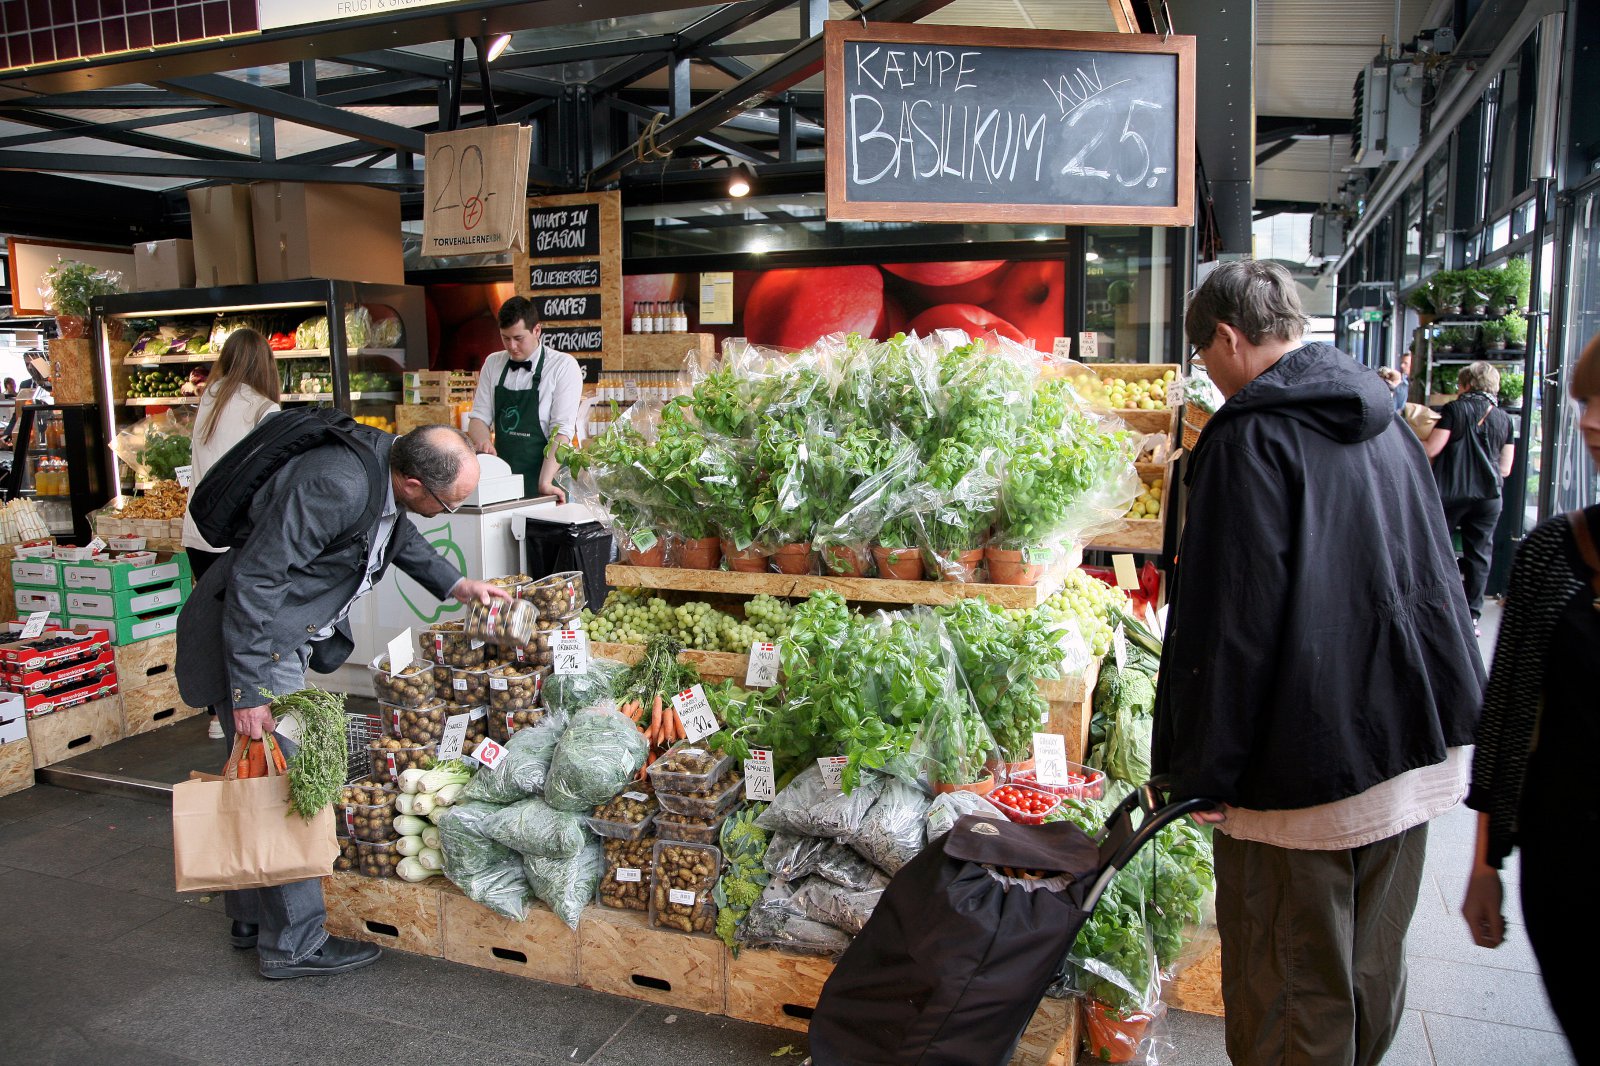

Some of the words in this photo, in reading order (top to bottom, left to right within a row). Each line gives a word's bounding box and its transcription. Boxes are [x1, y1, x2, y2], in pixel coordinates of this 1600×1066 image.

[856, 45, 982, 92] KÆMPE
[1043, 58, 1103, 113] KUN
[850, 93, 1047, 185] BASILIKUM
[532, 210, 568, 230] WHAT'S
[569, 209, 588, 227] IN
[536, 228, 586, 252] SEASON
[531, 269, 598, 287] BLUEBERRIES
[543, 296, 587, 316] GRAPES
